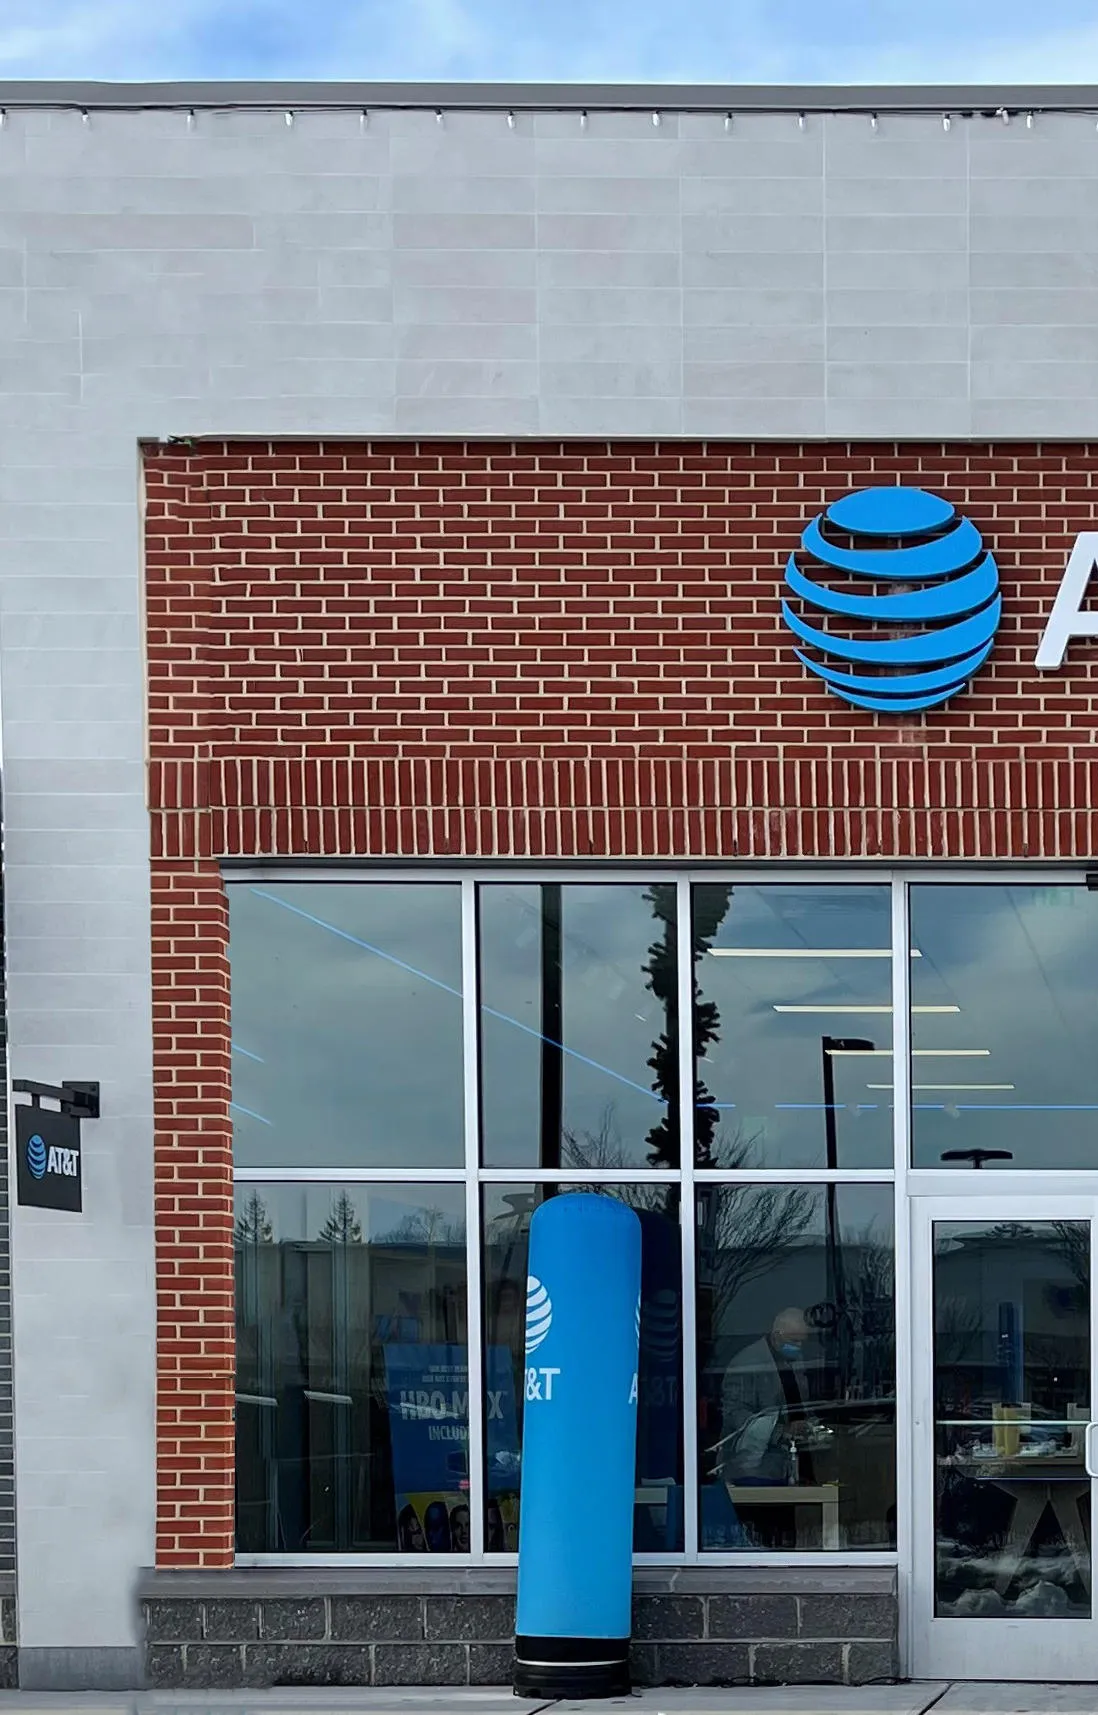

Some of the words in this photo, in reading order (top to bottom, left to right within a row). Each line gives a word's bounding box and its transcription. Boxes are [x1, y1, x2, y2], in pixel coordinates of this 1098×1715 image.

[47, 1146, 79, 1177] AT&T
[400, 1390, 446, 1420] HBO
[452, 1390, 504, 1419] MX
